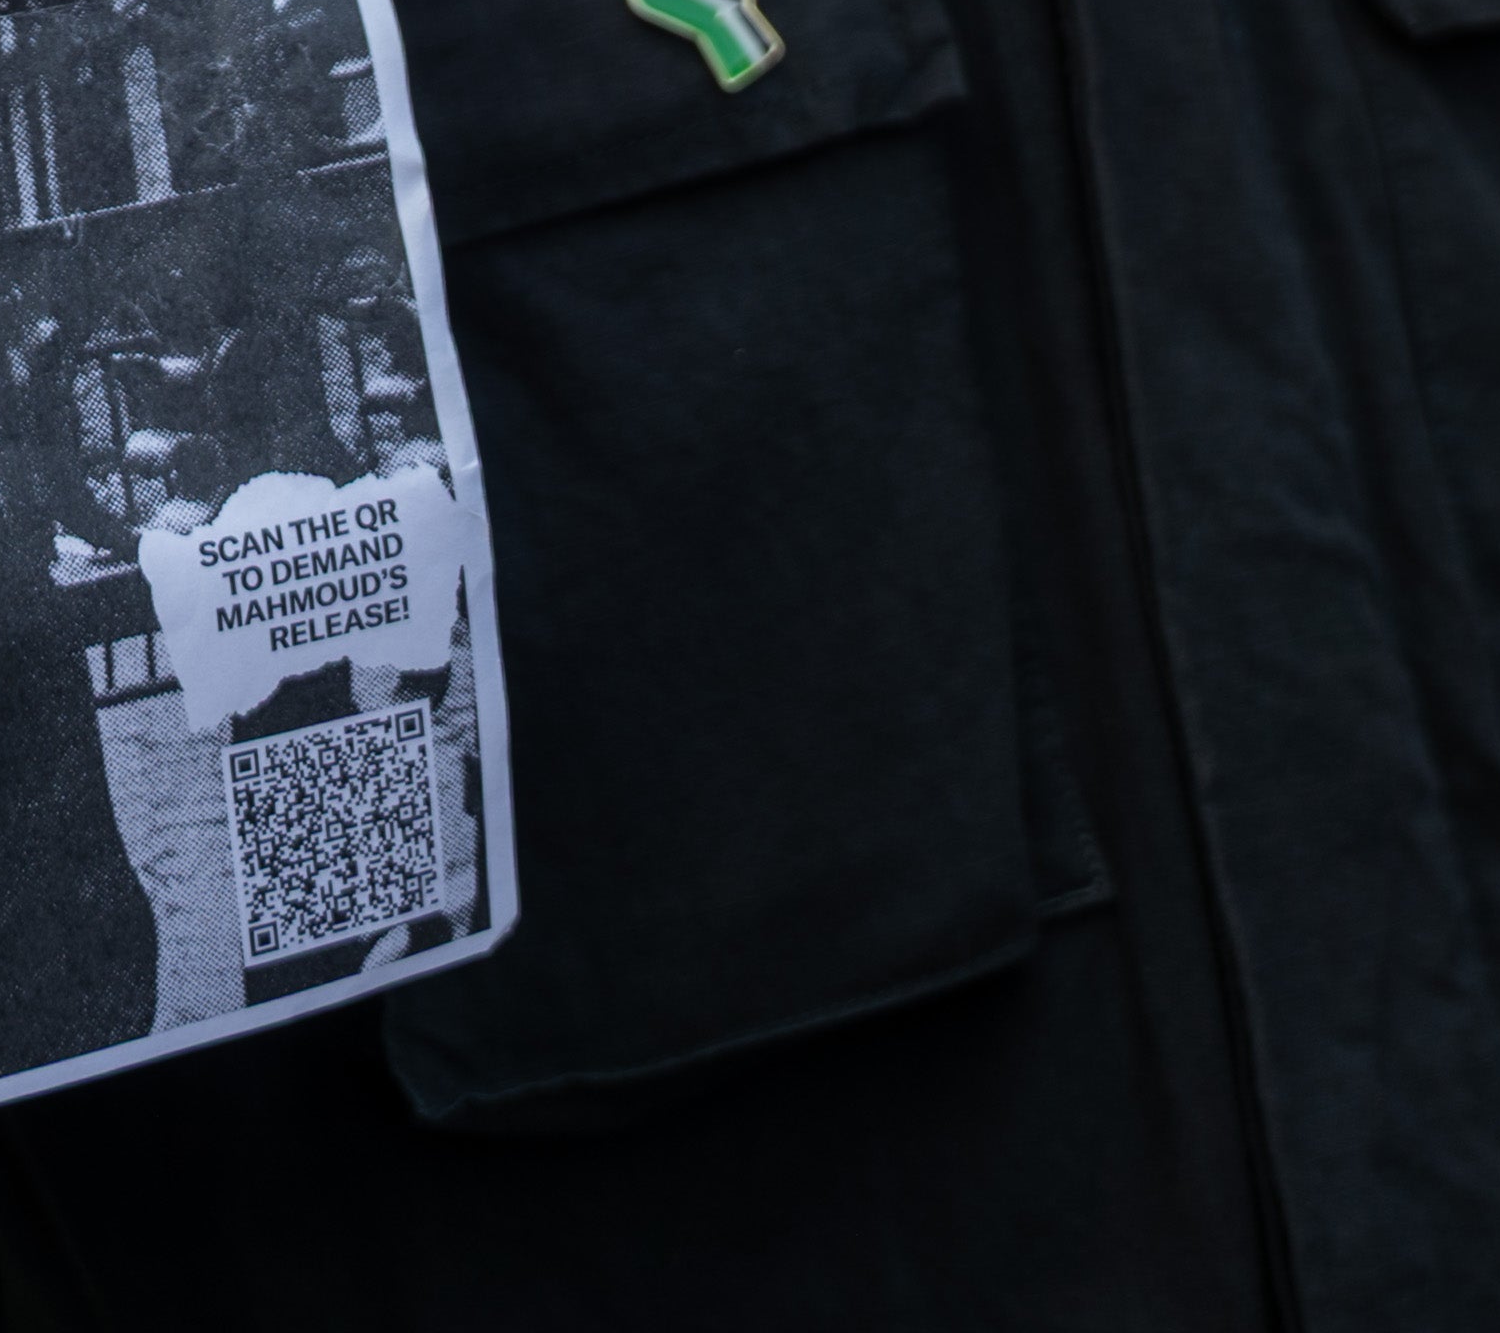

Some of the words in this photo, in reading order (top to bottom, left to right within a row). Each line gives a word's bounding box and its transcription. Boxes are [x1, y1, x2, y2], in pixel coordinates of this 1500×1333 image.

[198, 525, 284, 568] SCAN
[288, 509, 351, 546] THE
[355, 499, 399, 537] QR
[222, 565, 264, 597] TO
[270, 532, 405, 586] DEMAND
[216, 564, 409, 632] MAHMOUD’S
[269, 595, 411, 653] RELEASE!
